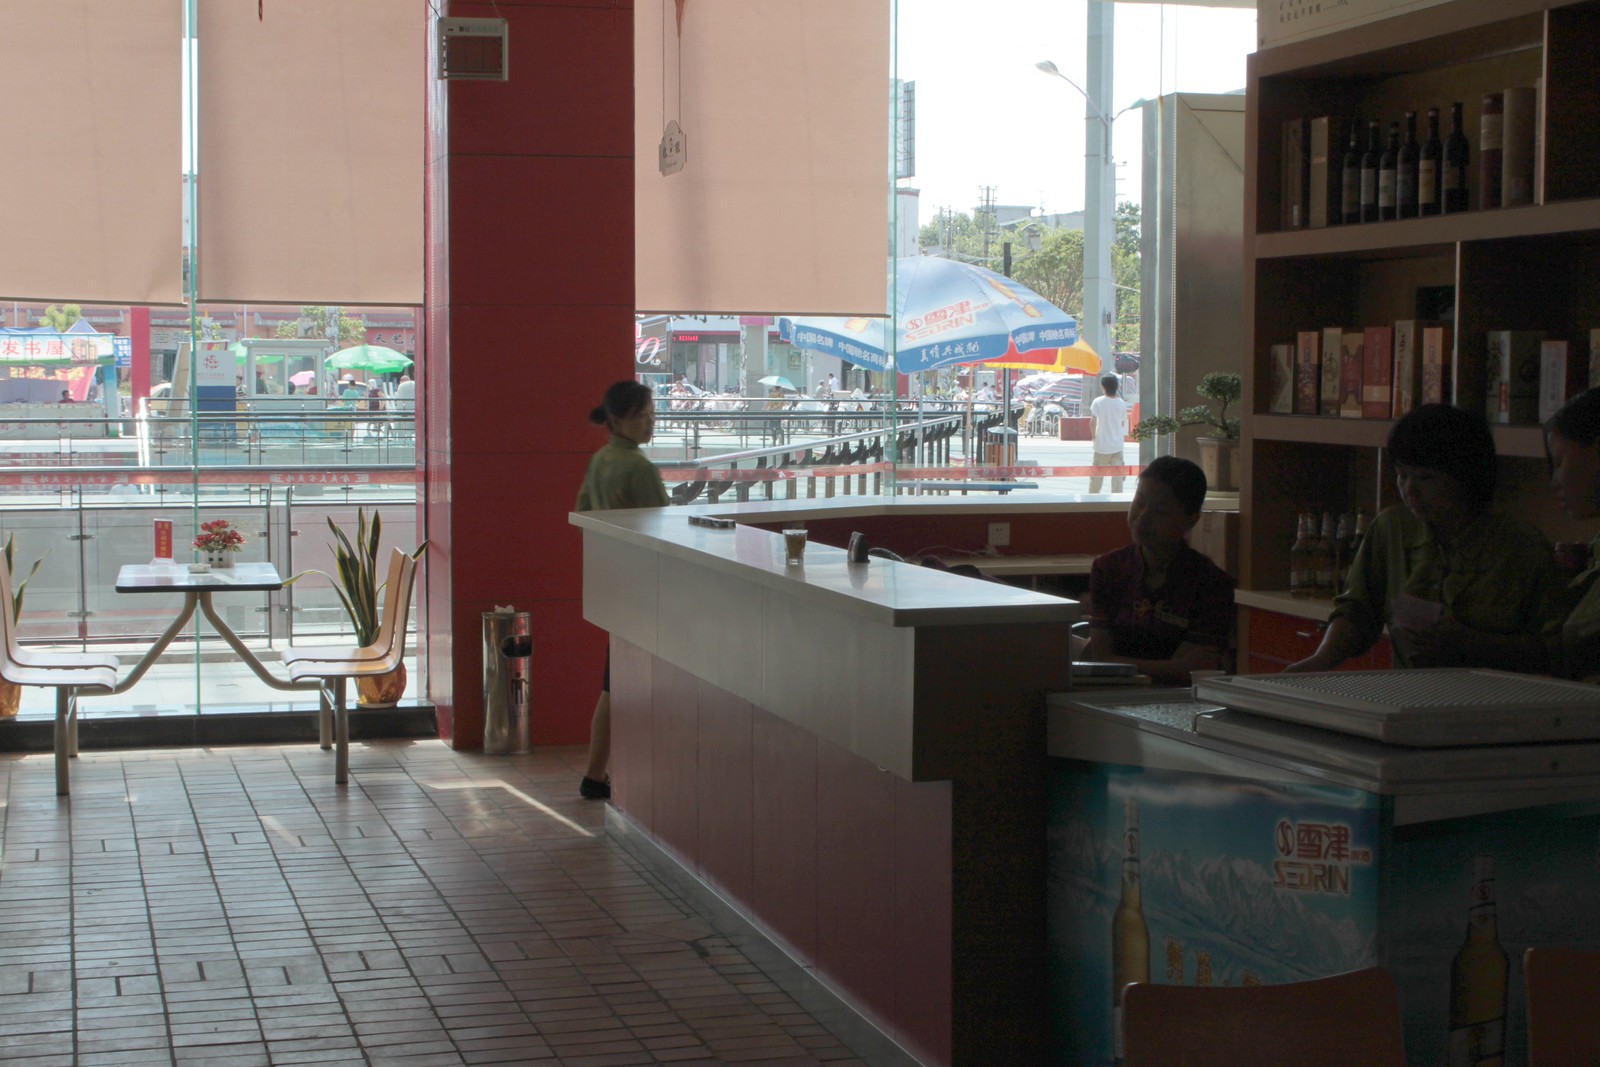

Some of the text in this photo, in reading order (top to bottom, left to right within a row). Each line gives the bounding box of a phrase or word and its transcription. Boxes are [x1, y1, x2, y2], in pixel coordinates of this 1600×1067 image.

[924, 300, 972, 326] 雪津
[2, 340, 65, 356] 发书屋
[796, 331, 834, 348] 中国名牌
[920, 341, 980, 363] 真情共成就
[1297, 824, 1350, 861] 雪津
[1273, 861, 1349, 893] SEDRIN
